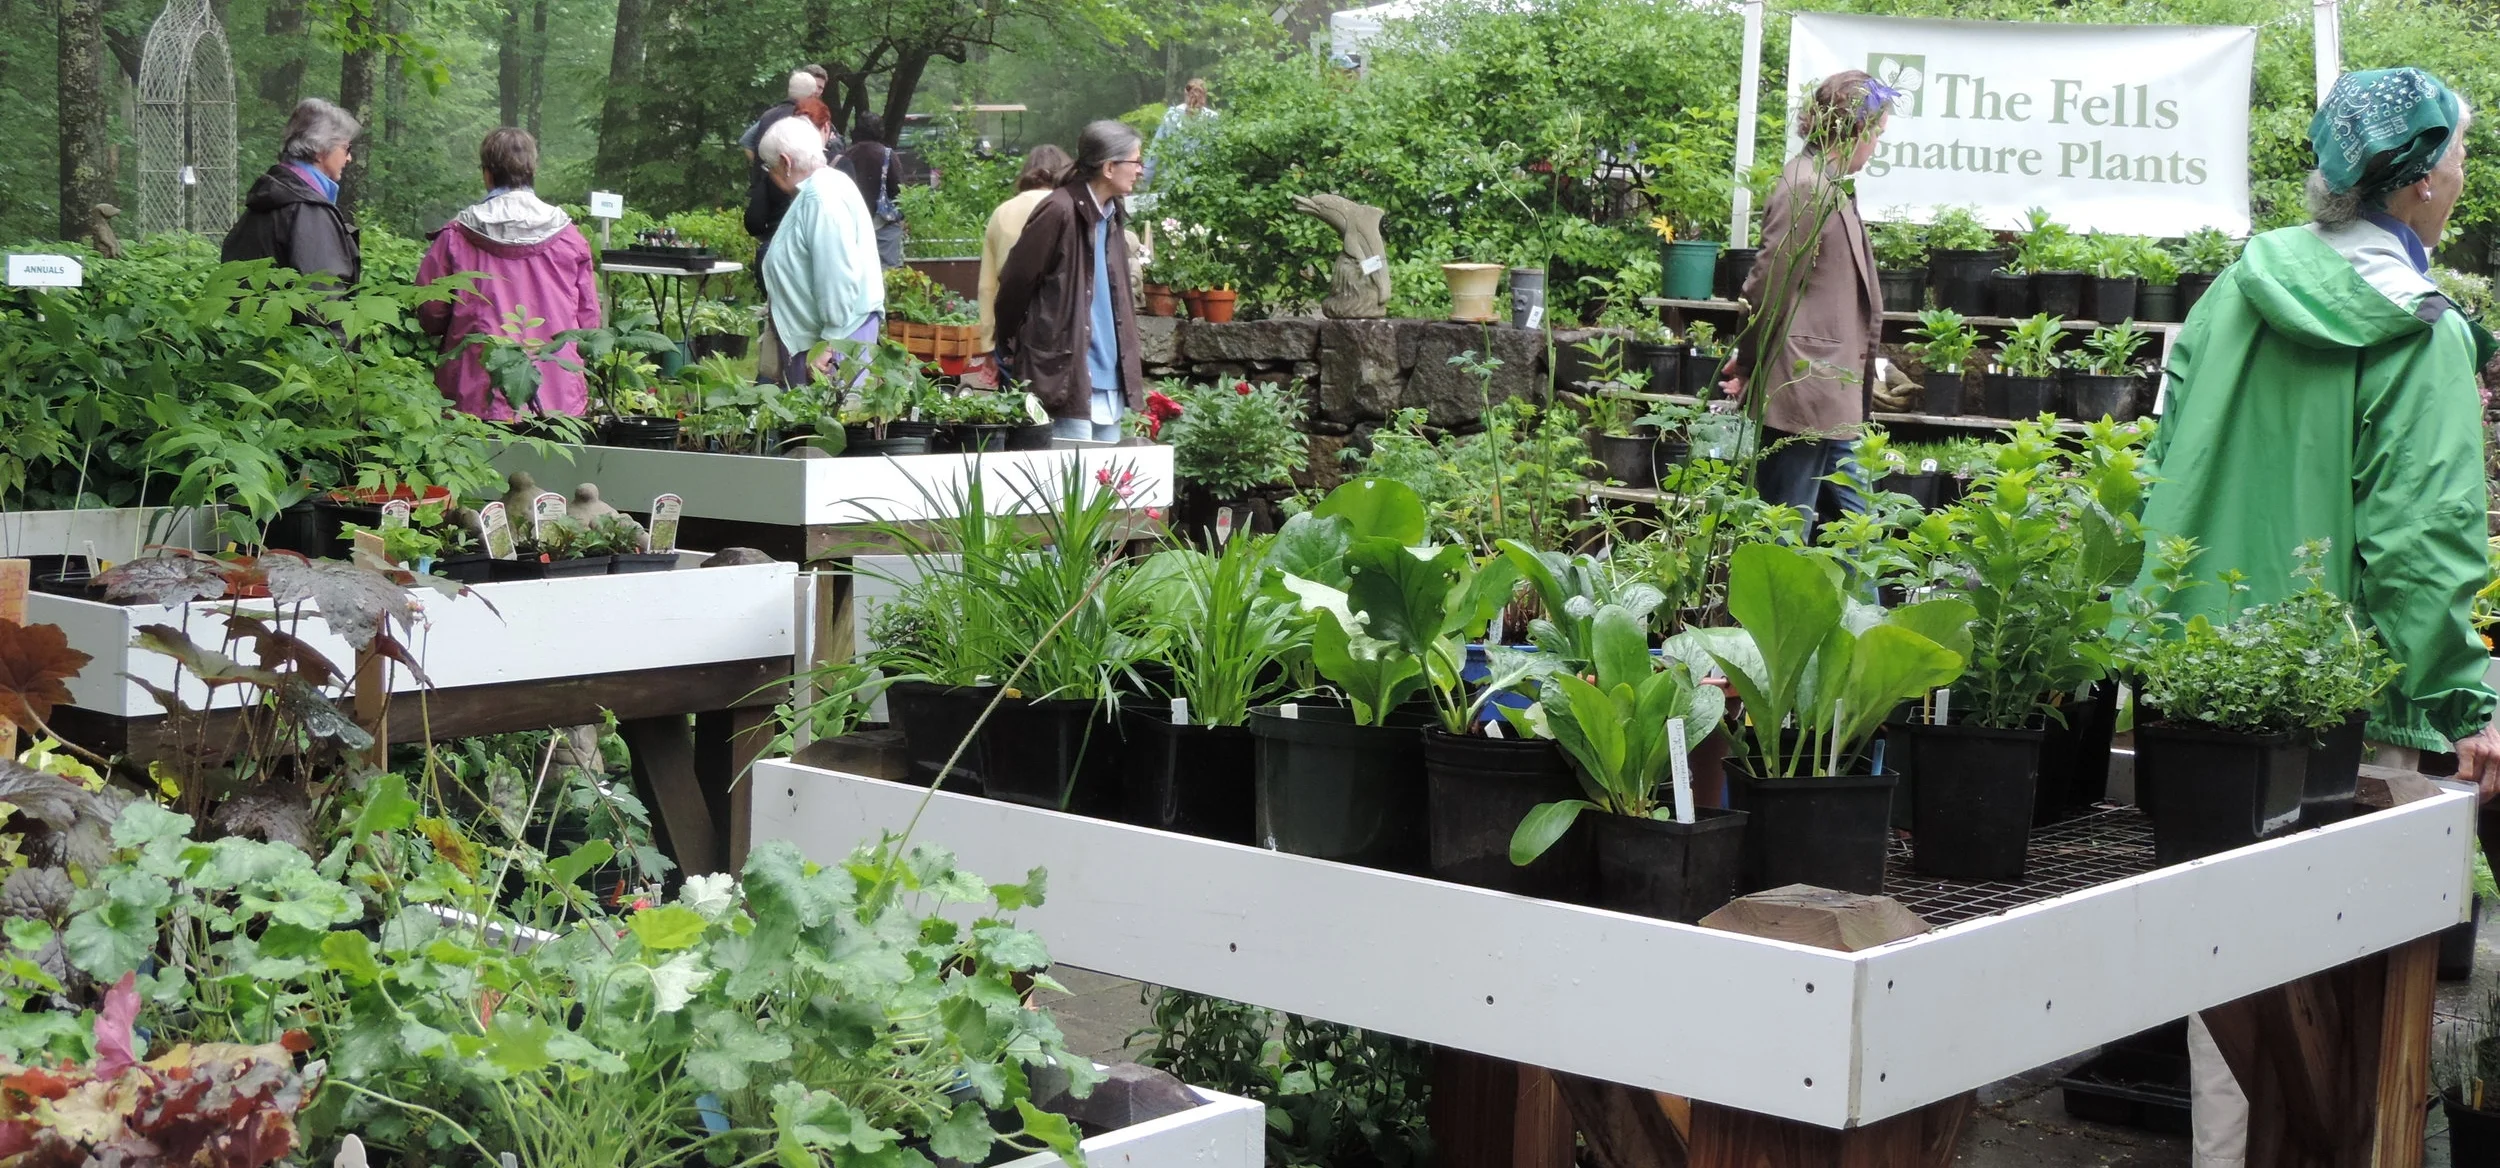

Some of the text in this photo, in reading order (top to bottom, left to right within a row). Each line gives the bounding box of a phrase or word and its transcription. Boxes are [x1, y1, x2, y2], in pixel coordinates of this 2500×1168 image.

[1935, 72, 2179, 130] The Fells
[1865, 138, 2208, 186] gnature Plants
[24, 265, 65, 274] ANNUALS
